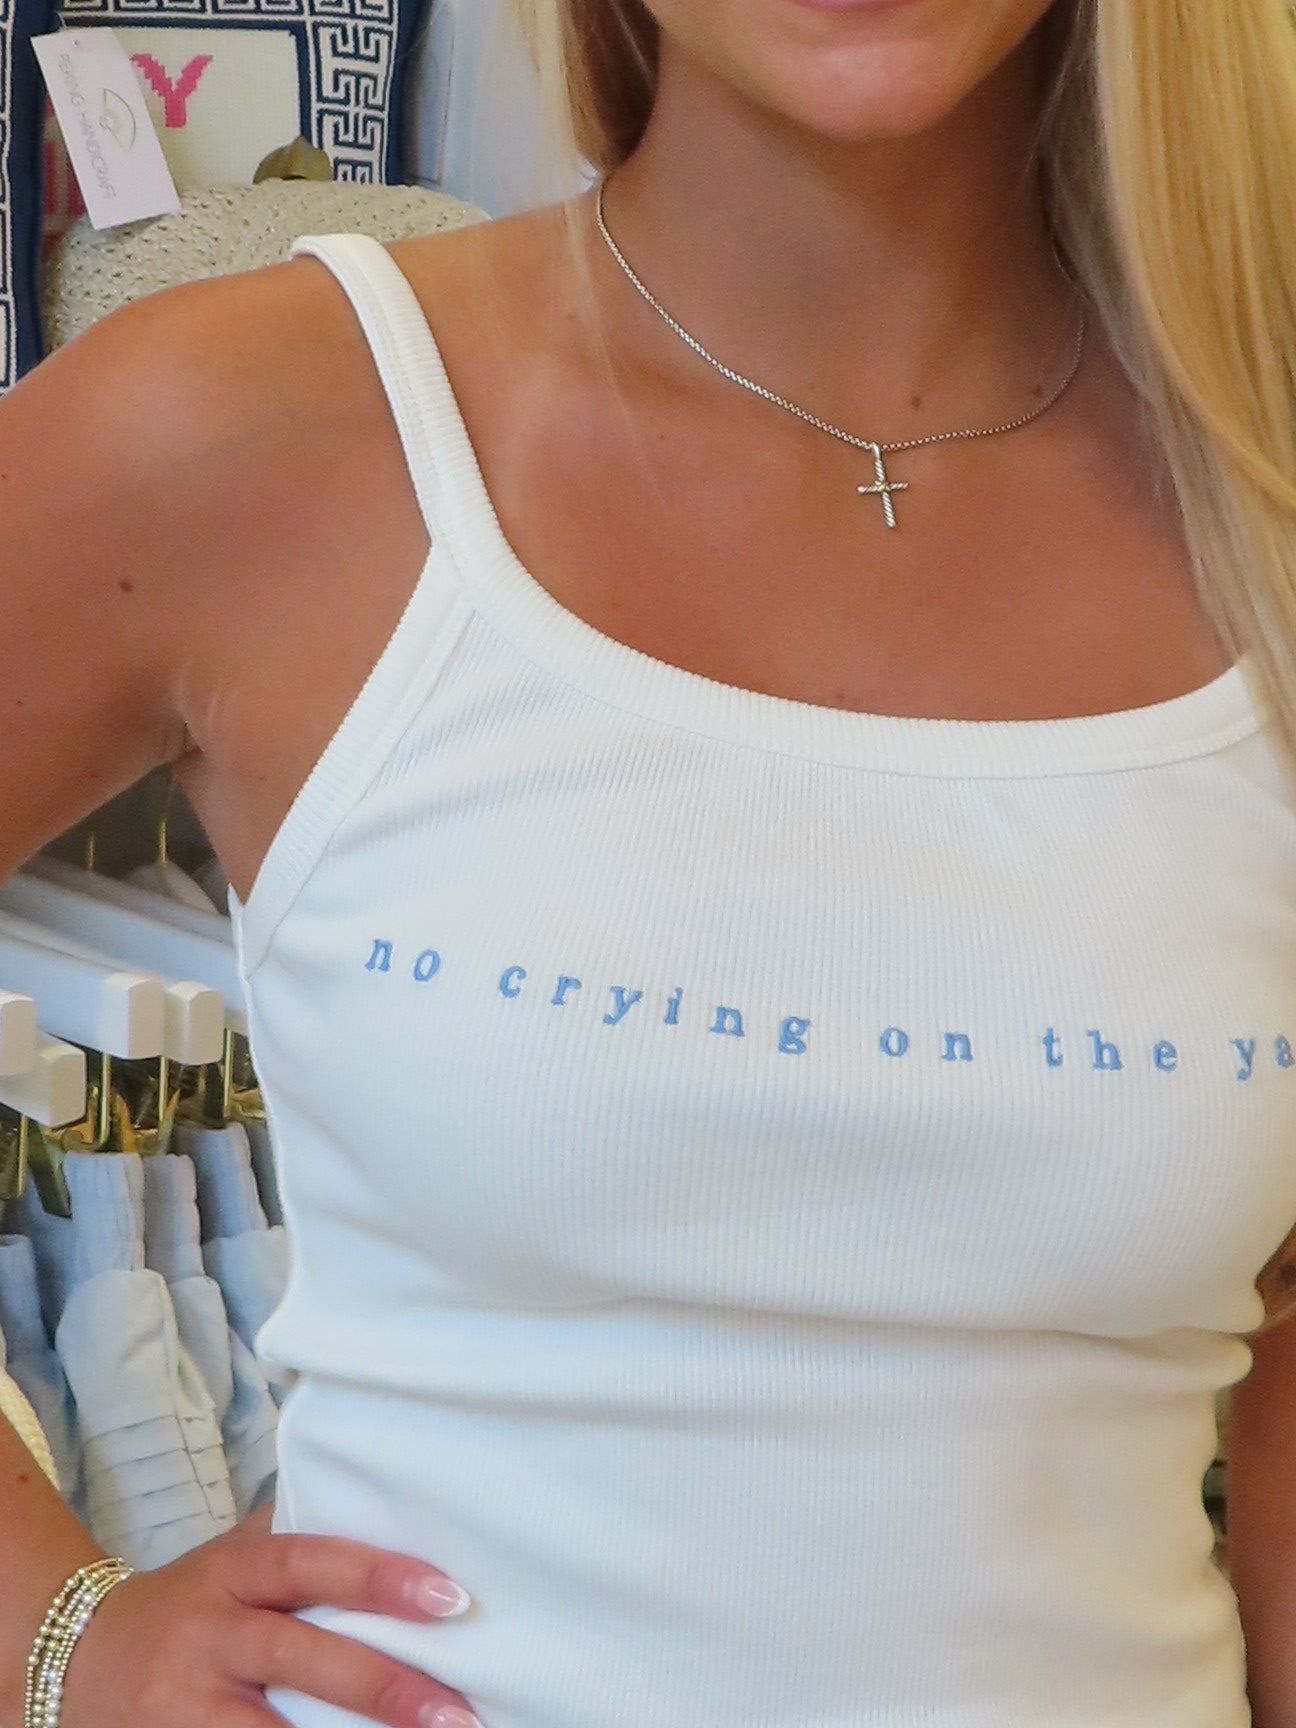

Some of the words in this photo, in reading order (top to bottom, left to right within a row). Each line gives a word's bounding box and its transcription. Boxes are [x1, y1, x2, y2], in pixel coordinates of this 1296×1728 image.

[362, 936, 442, 985] no
[497, 963, 811, 1057] crying
[878, 1027, 974, 1063] on
[1040, 1026, 1178, 1073] the
